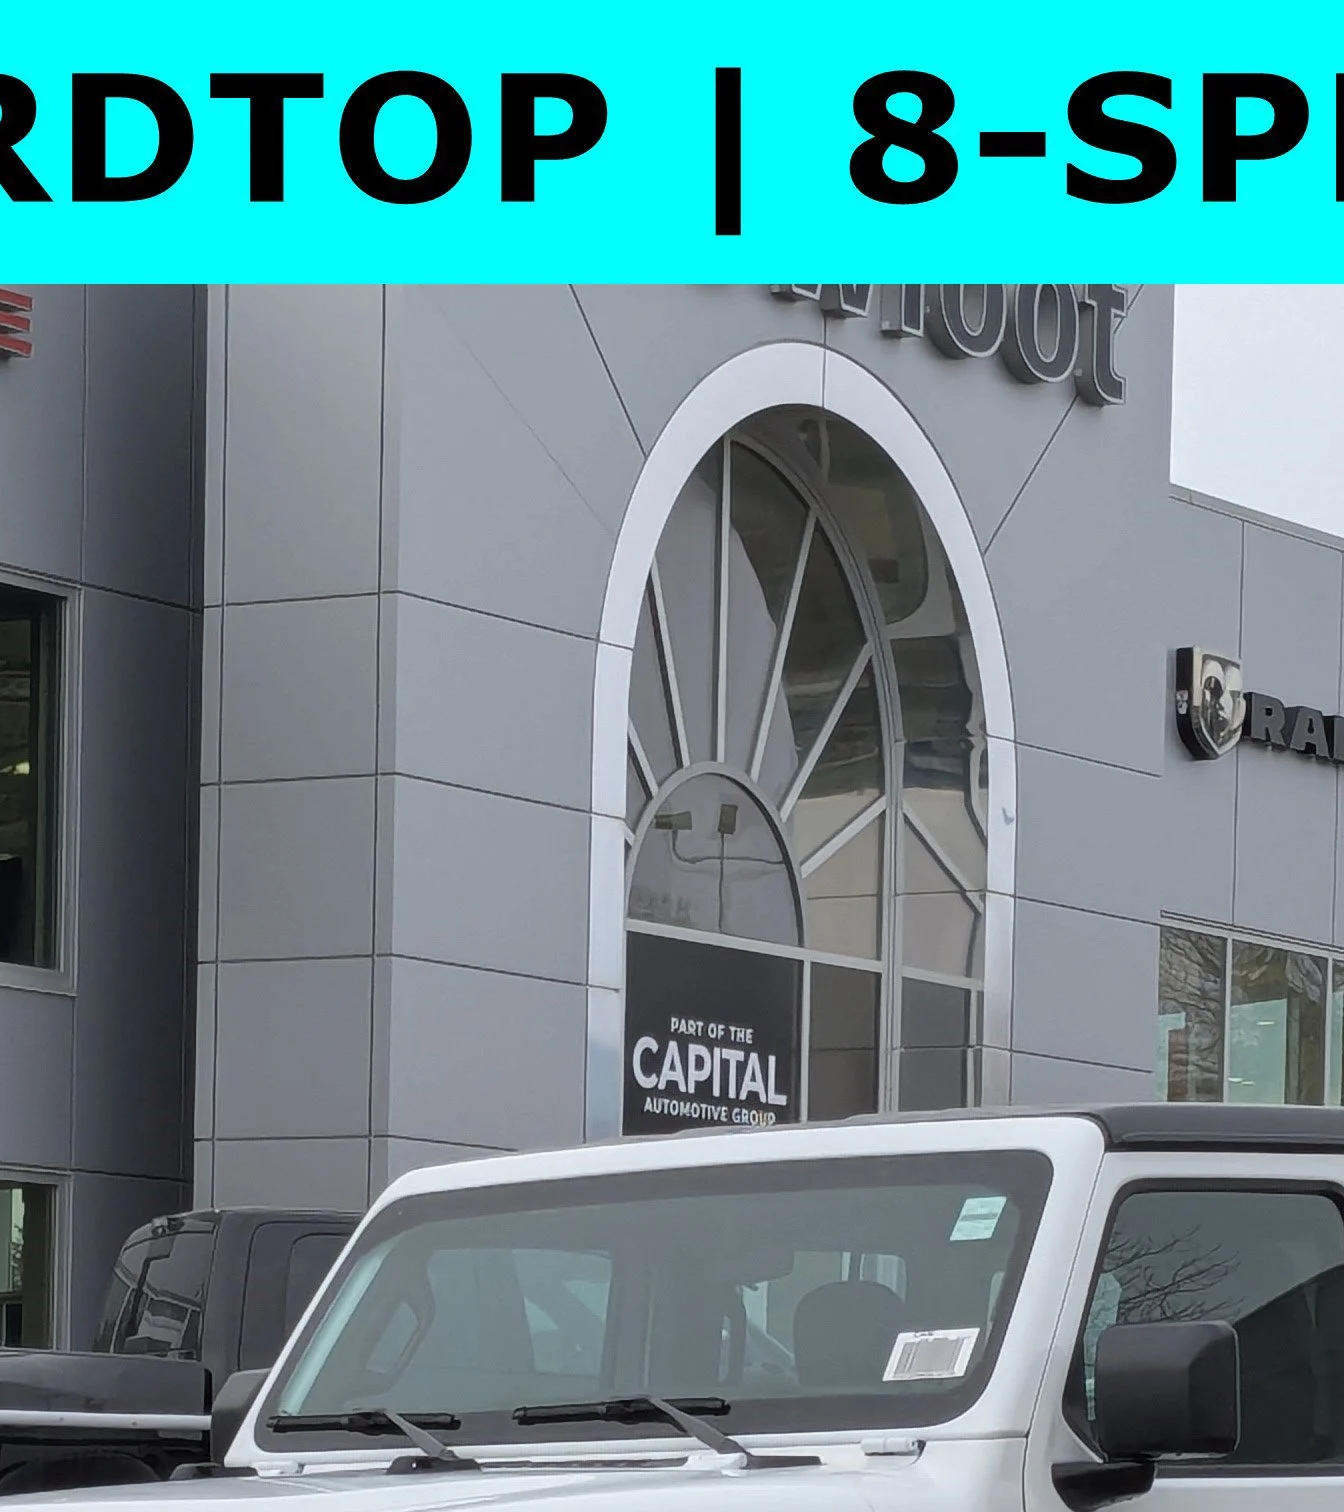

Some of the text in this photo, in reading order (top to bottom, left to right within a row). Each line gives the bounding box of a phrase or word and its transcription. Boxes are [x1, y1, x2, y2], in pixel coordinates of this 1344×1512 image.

[670, 1017, 754, 1044] PART OF THE
[632, 1036, 788, 1106] CAPITAL
[643, 1096, 776, 1127] AUTOMOTIVE GROUP
